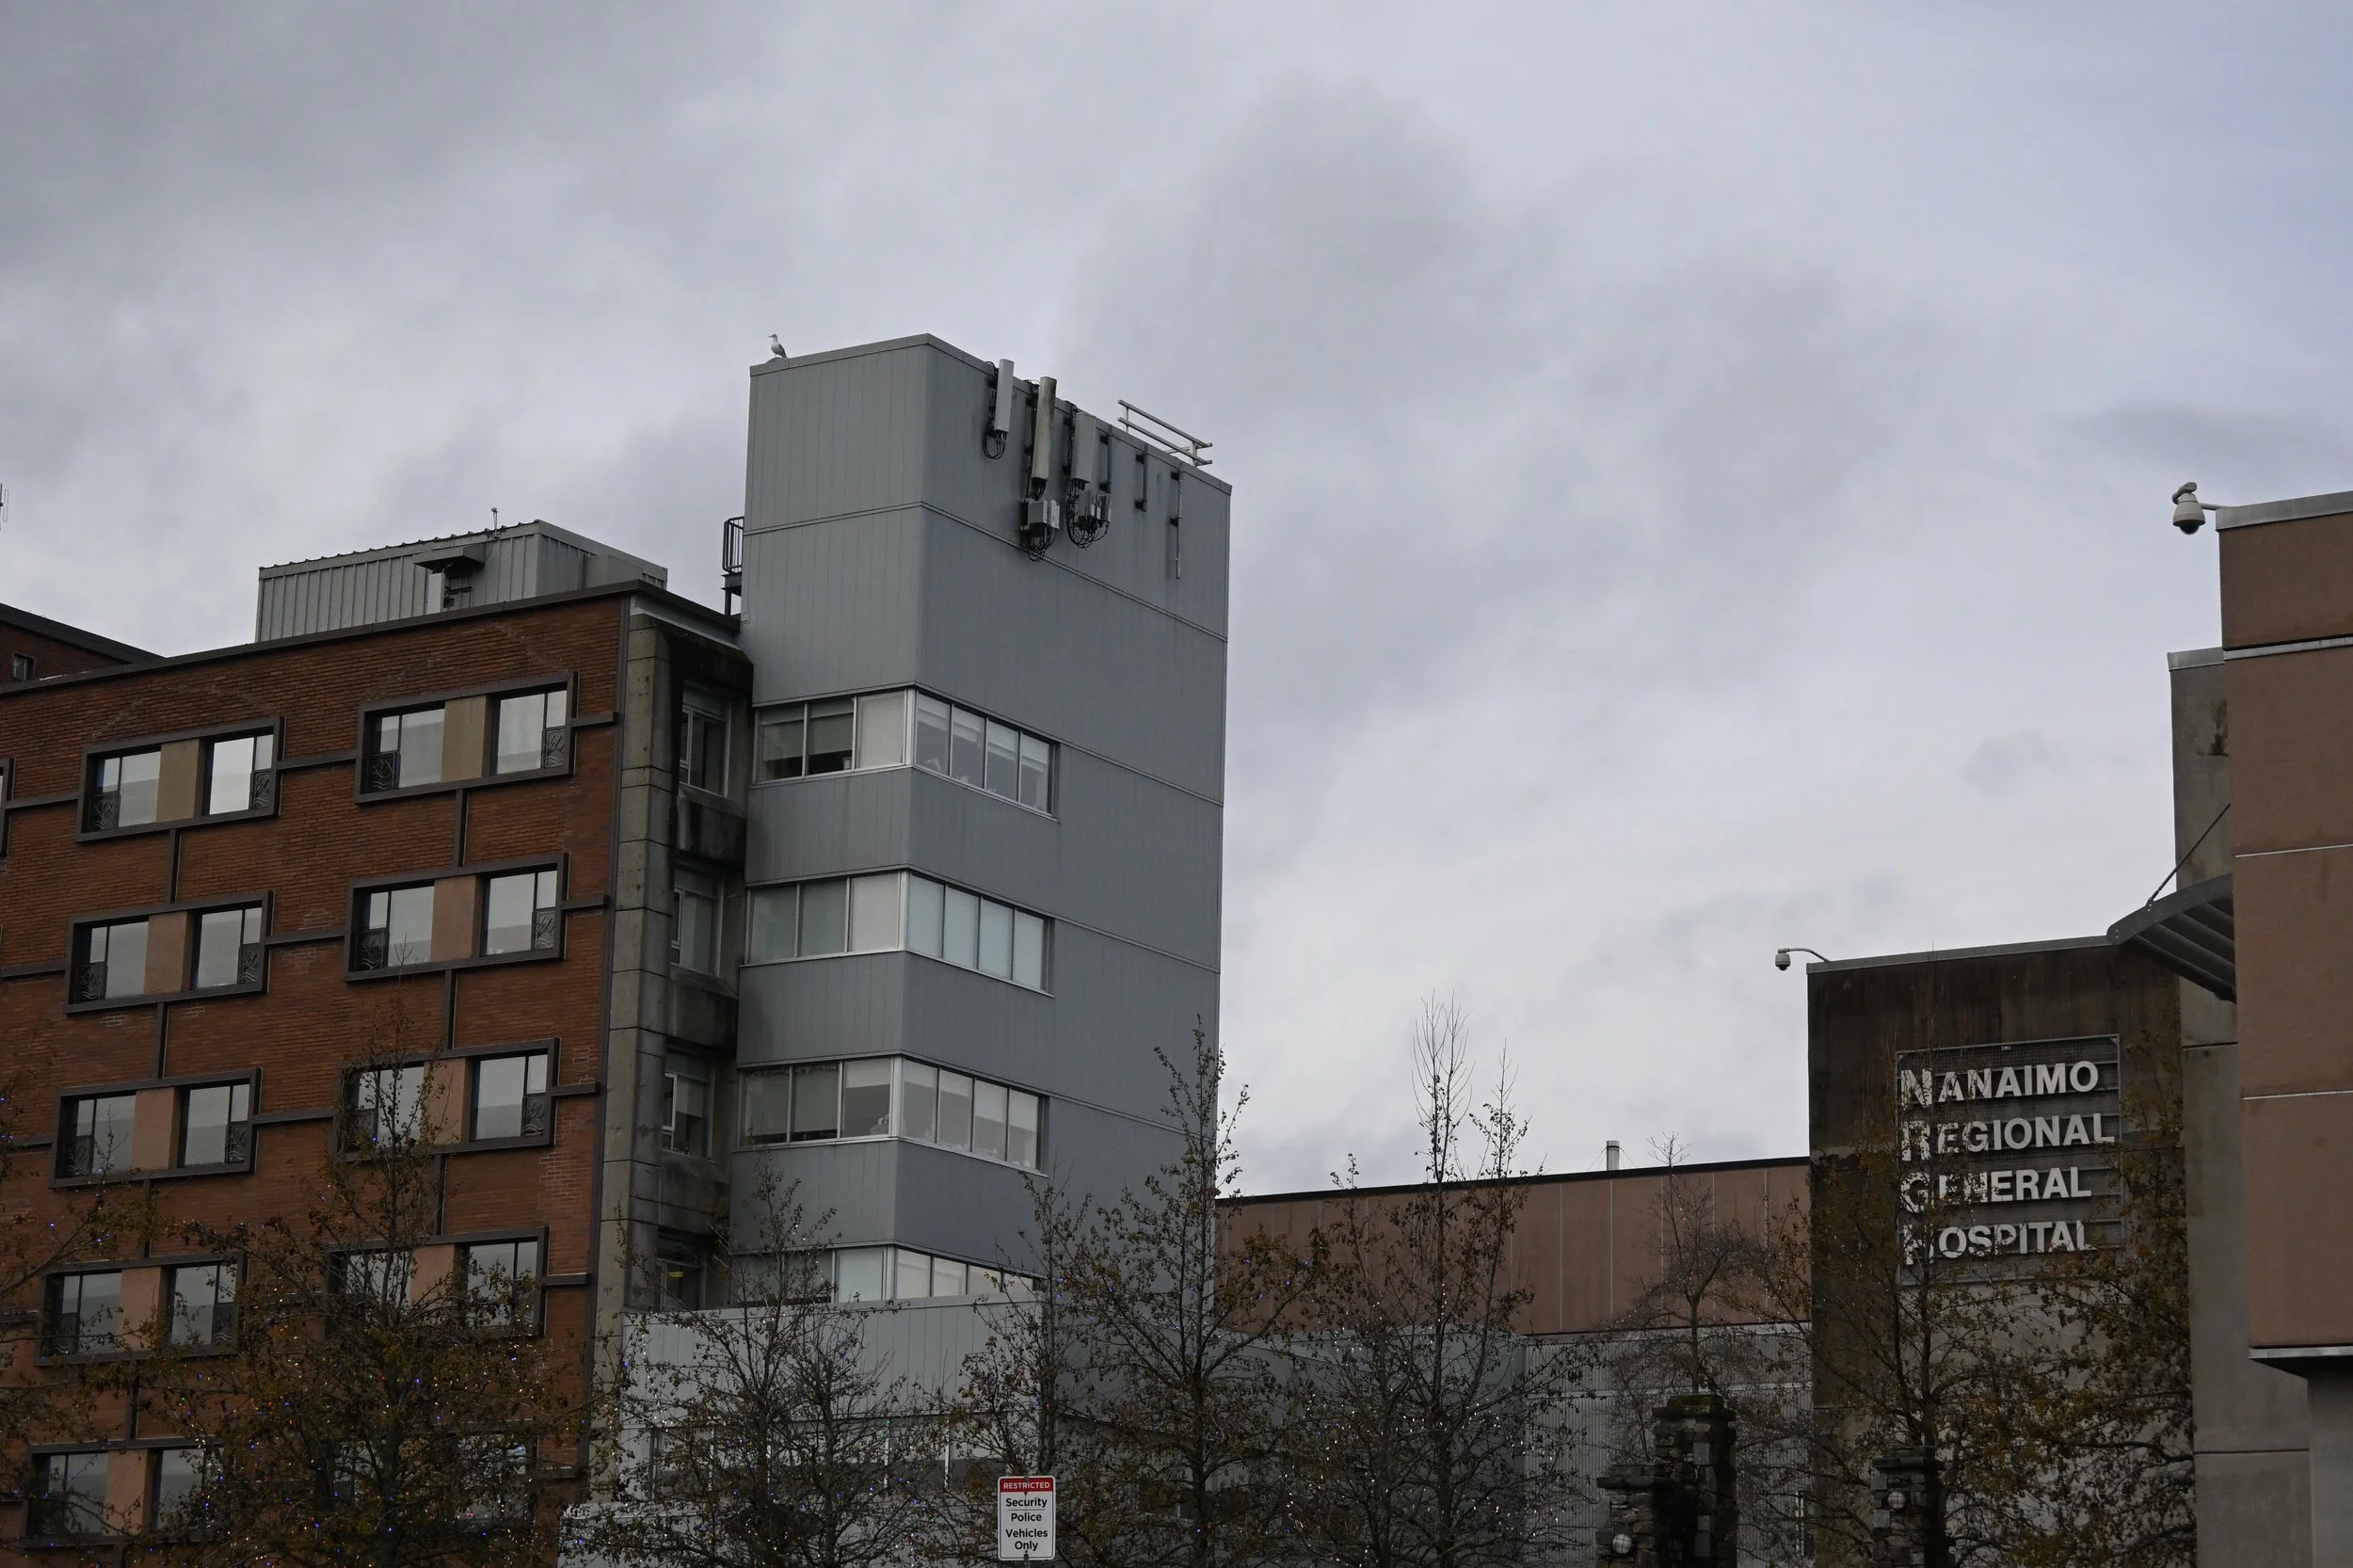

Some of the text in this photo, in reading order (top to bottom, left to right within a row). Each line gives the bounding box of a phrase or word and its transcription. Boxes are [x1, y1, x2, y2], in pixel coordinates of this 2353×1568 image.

[1899, 1060, 2100, 1109] NANAIMO
[1901, 1112, 2116, 1161] REGIONAL
[1900, 1166, 2093, 1213] GENERAL
[1005, 1497, 1048, 1508] Security
[1011, 1512, 1042, 1522] Police
[1005, 1528, 1048, 1538] Vehicles
[1015, 1541, 1038, 1551] Only
